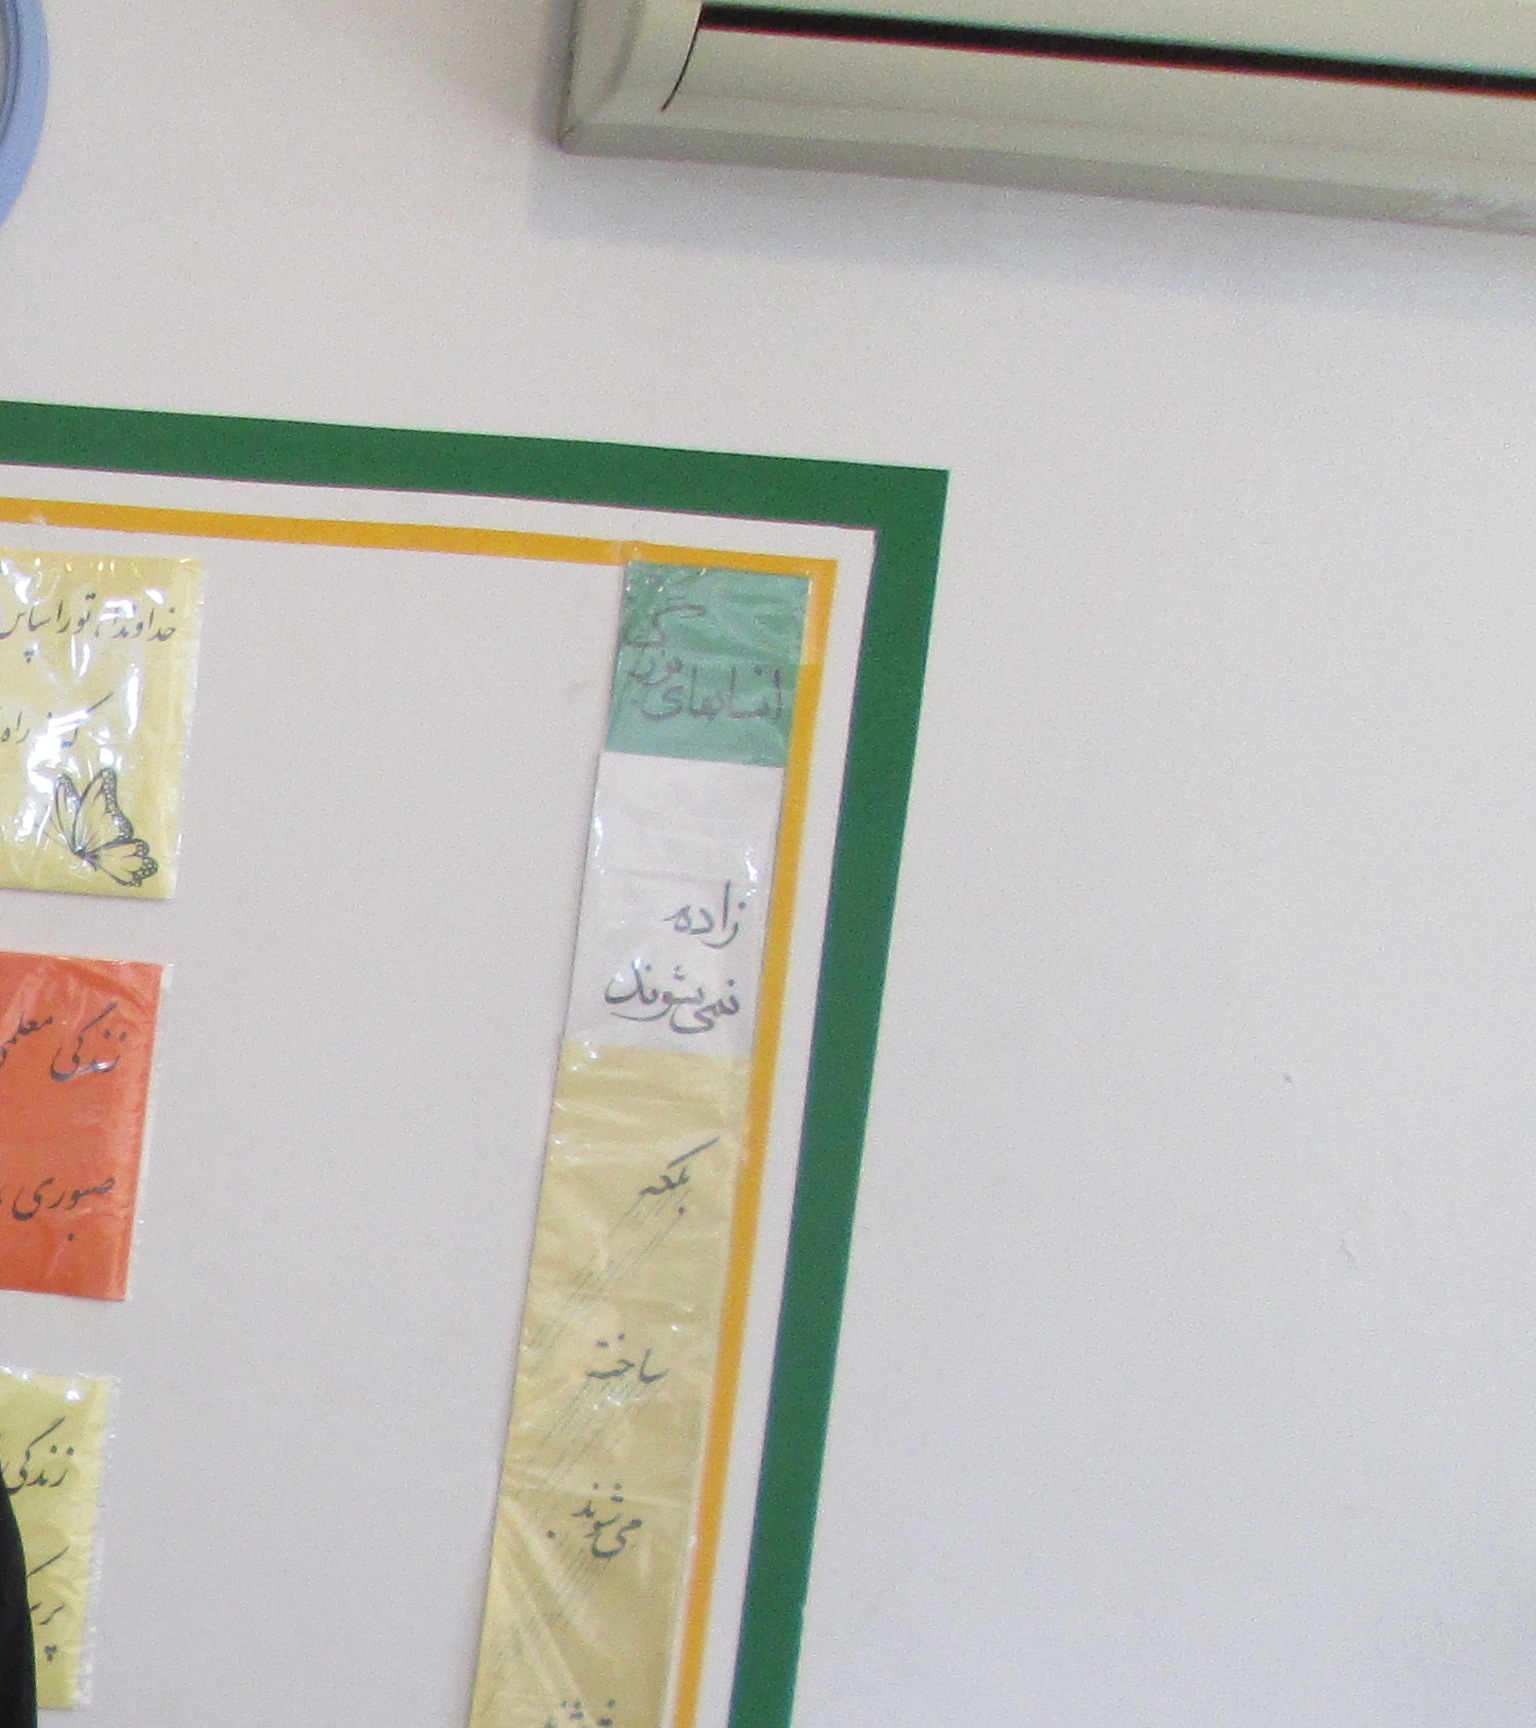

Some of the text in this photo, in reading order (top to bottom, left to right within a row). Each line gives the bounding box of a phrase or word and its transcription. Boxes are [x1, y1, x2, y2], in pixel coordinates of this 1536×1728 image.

[664, 881, 746, 949] زاده
[50, 1002, 128, 1082] زندگی
[584, 1333, 670, 1383] ساخته
